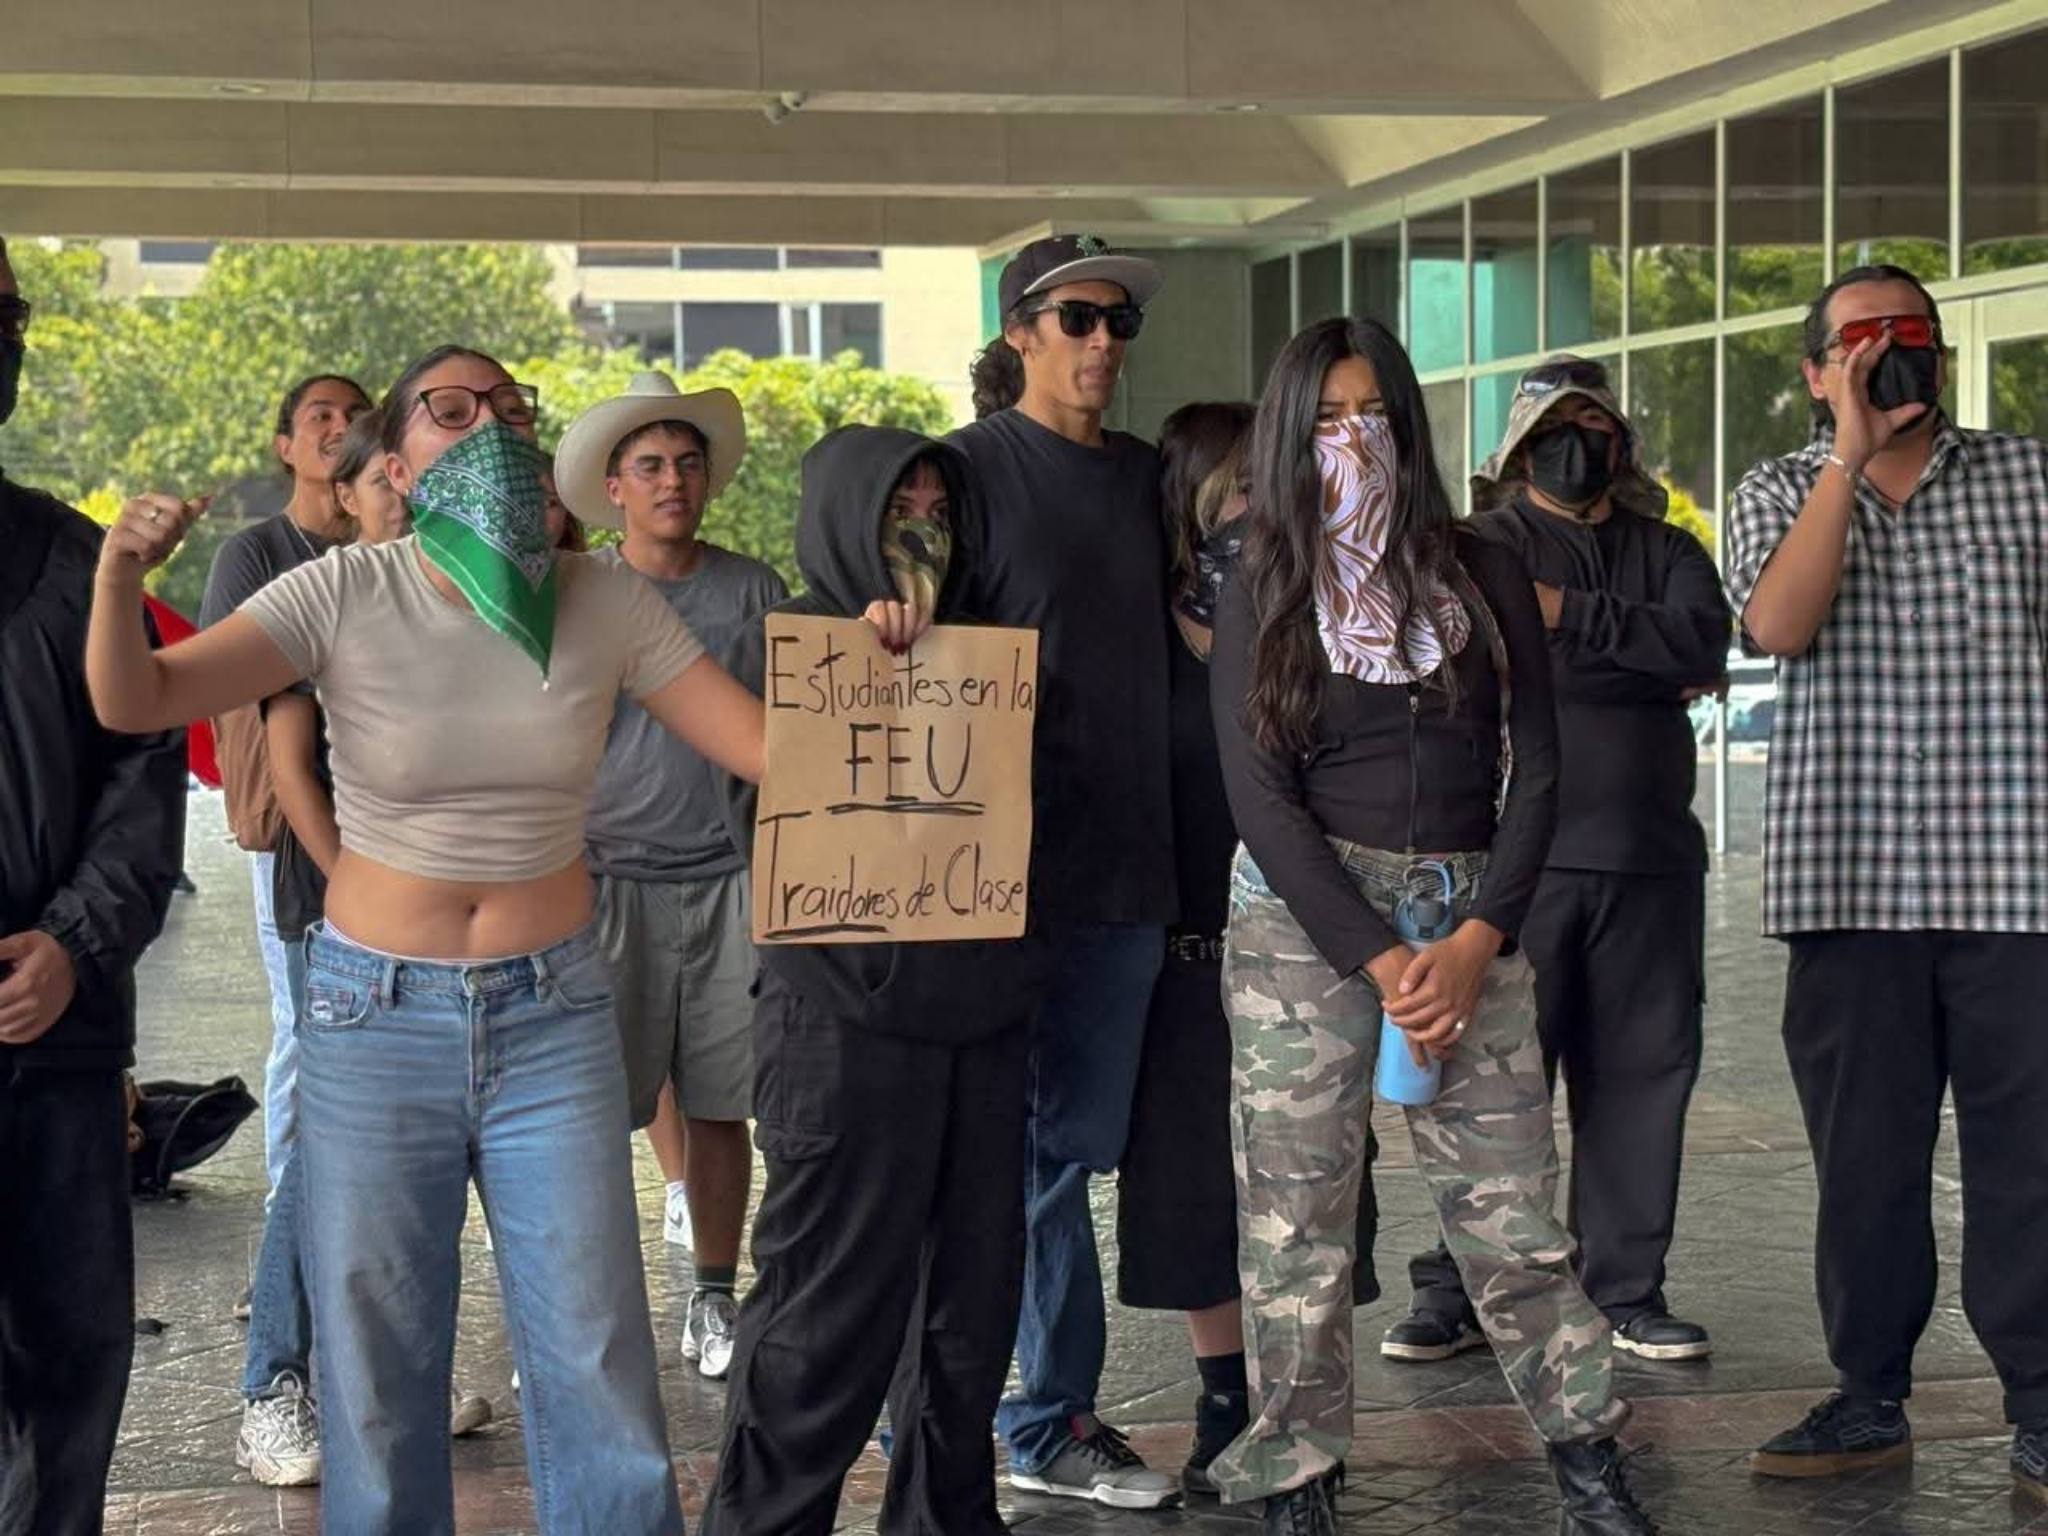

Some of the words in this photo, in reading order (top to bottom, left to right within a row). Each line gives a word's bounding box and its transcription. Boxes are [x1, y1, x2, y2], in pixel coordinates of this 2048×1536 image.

[769, 633, 952, 716] Estudiantes
[960, 677, 998, 709] en
[1010, 647, 1033, 711] la
[845, 723, 971, 802] FEU
[758, 810, 899, 928] Traidores
[905, 854, 935, 916] de
[944, 842, 1023, 917] Clase
